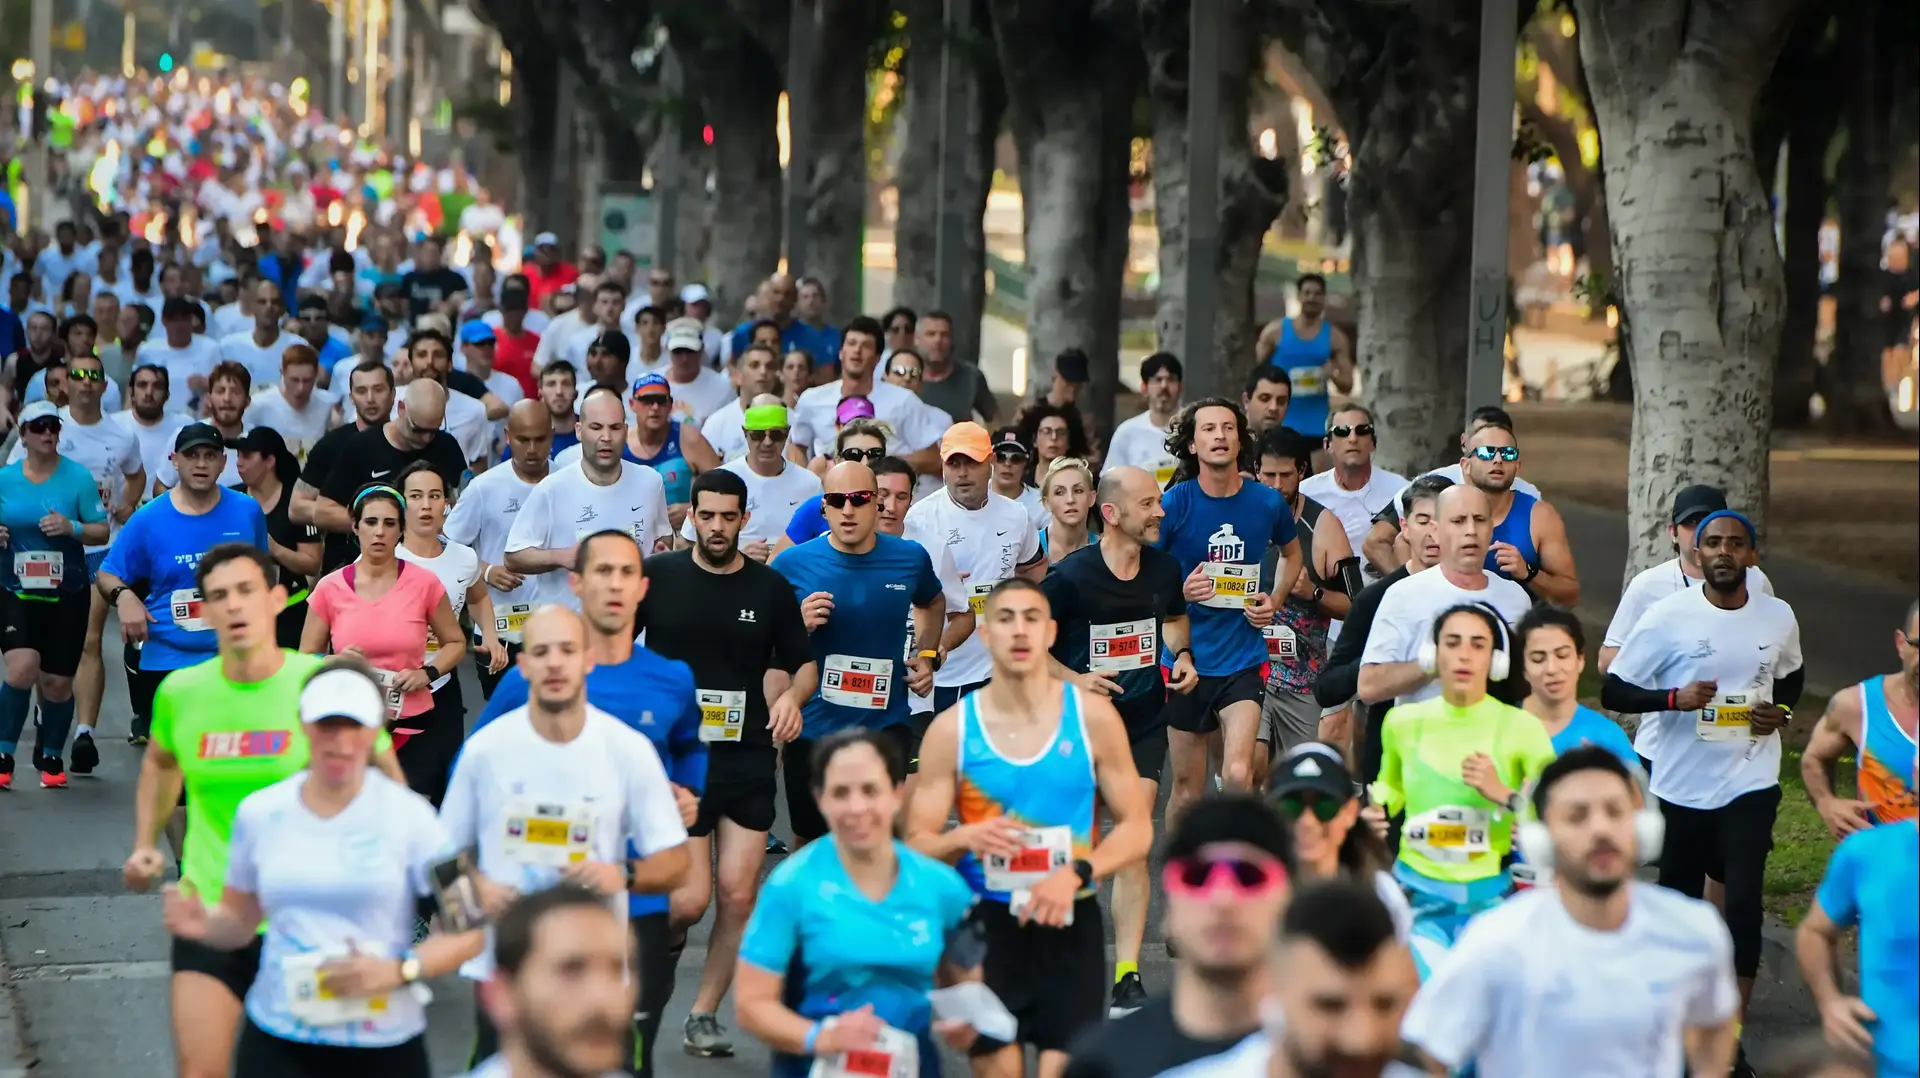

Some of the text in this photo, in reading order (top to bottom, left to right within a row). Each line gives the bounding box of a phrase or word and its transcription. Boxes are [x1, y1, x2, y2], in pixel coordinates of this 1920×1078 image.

[1223, 581, 1245, 591] 10824
[1119, 640, 1137, 651] 5747
[852, 677, 871, 689] 8211
